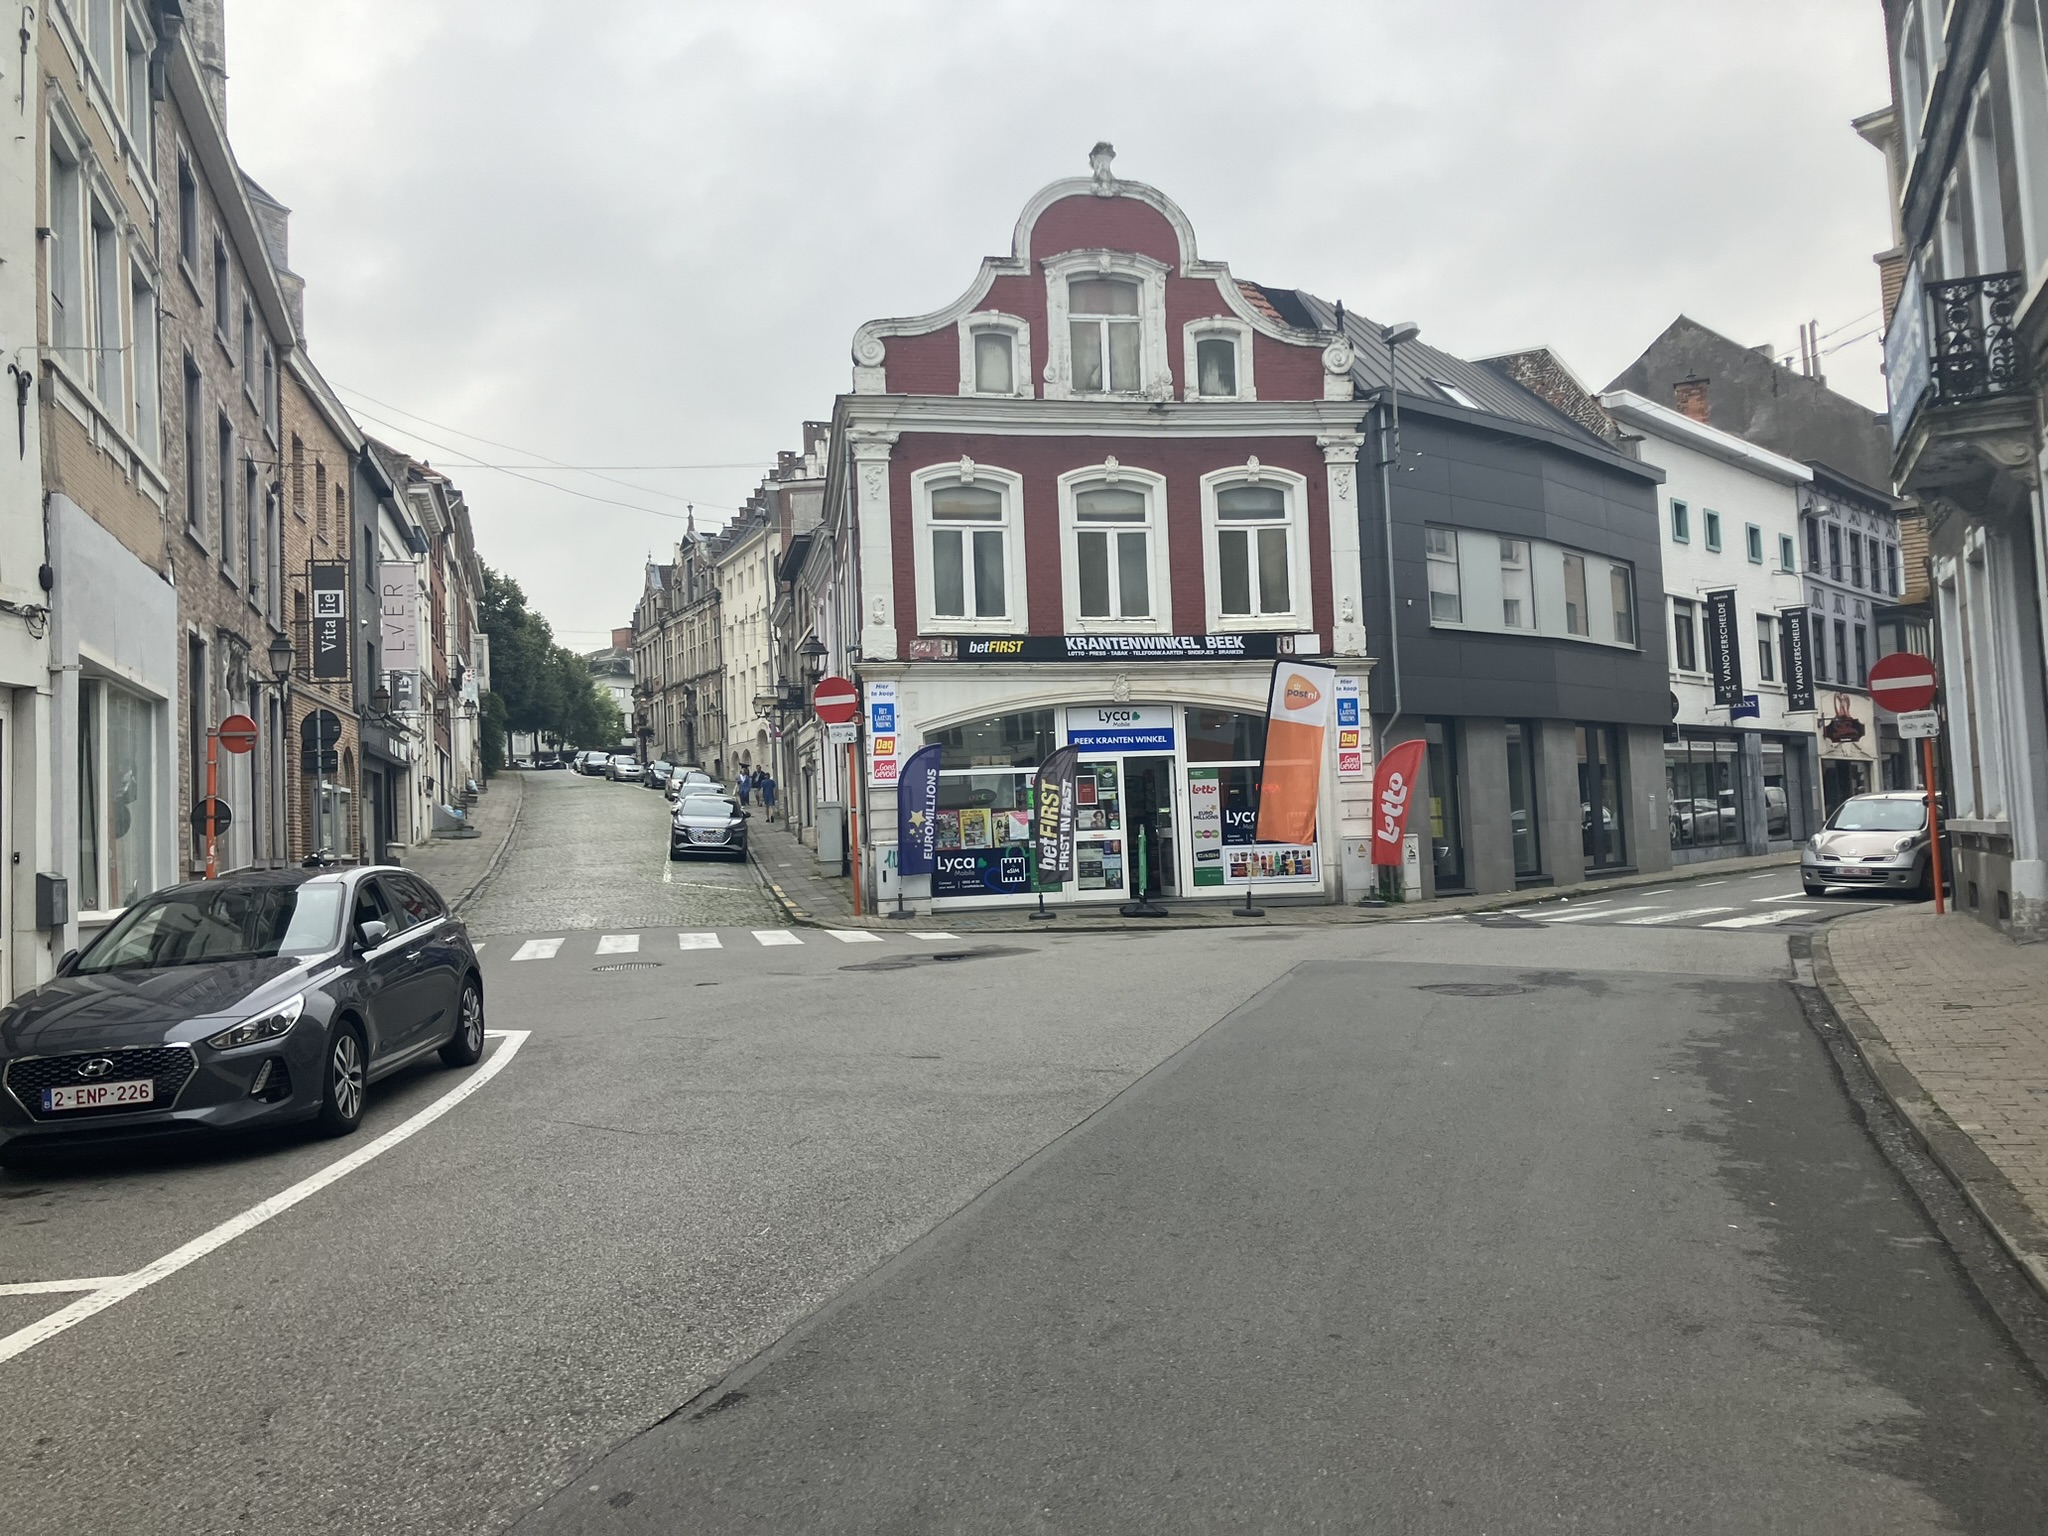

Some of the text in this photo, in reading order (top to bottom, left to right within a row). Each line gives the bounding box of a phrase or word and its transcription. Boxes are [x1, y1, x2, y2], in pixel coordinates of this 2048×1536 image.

[969, 640, 1023, 653] betFIRST
[1065, 636, 1245, 650] KRANTENWINKEL BEEK
[1718, 602, 1732, 682] VANOVERSCHELDE
[1791, 618, 1804, 690] VANOVERSCHELDE
[1287, 689, 1318, 700] postnl
[1098, 709, 1130, 723] Lyca
[876, 739, 894, 753] Dag
[1096, 736, 1134, 744] KRANTEN
[1135, 735, 1167, 743] WINKEL
[1341, 733, 1357, 746] Dag
[1340, 762, 1359, 770] Gevoel
[1344, 755, 1359, 763] Goed
[875, 769, 896, 777] Gevoel
[1192, 784, 1217, 794] Lotto
[924, 768, 937, 860] EUROMILLIONS
[1377, 772, 1408, 844] Lotto
[1039, 778, 1060, 871] betFIRST
[1059, 778, 1073, 871] FIRST IN FAST
[937, 856, 975, 873] Lyca
[54, 1083, 149, 1107] 2-ENP-226
[44, 1101, 50, 1109] B
